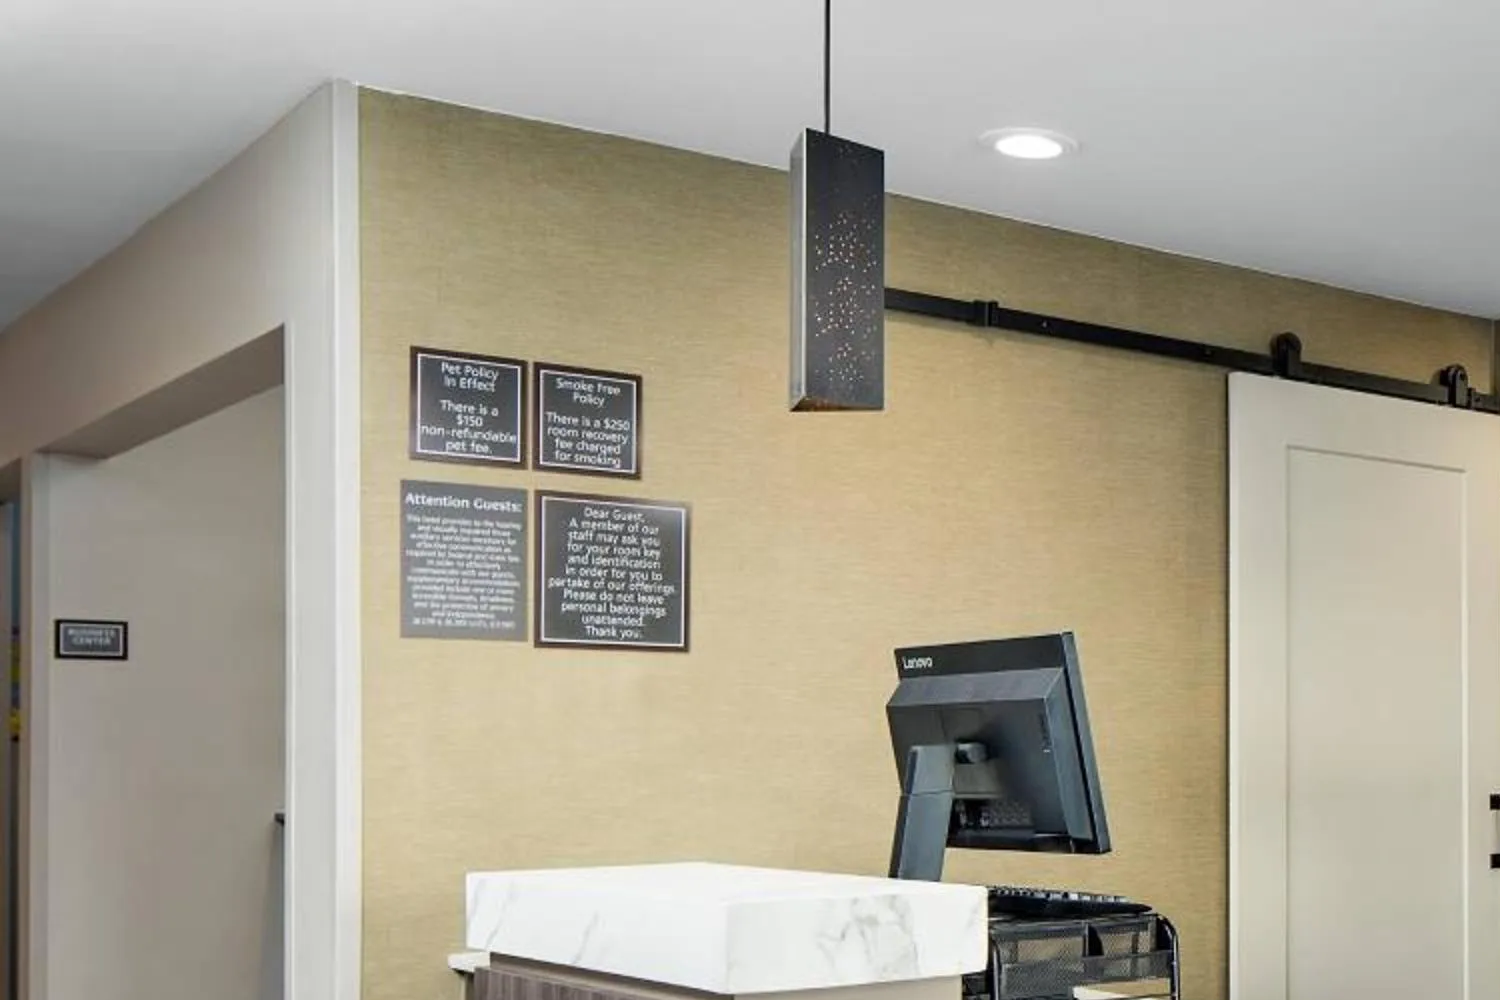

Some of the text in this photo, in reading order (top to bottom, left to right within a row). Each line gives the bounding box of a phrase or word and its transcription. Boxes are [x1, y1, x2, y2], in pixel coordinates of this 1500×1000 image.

[464, 365, 499, 381] Policy
[459, 377, 496, 392] Effect
[556, 377, 595, 393] Smoke
[573, 392, 605, 408] Policy
[440, 399, 475, 414] There
[491, 407, 499, 417] a
[456, 414, 483, 427] $150
[544, 411, 579, 425] There
[421, 425, 516, 443] non-refundable
[547, 427, 628, 445] room recovery
[445, 441, 467, 453] pet
[576, 440, 621, 455] charged
[555, 450, 572, 461] for
[405, 492, 470, 509] Attention
[583, 507, 610, 519] Dear
[569, 517, 659, 535] A member of our
[567, 530, 594, 542] staff
[596, 533, 619, 545] may
[566, 541, 584, 552] for
[586, 545, 610, 557] your
[613, 545, 640, 557] room
[567, 554, 660, 570] and identification
[579, 566, 609, 578] order
[611, 568, 626, 579] for
[628, 571, 649, 583] you
[547, 577, 590, 589] partake
[593, 578, 604, 588] of
[607, 581, 626, 591] our
[563, 588, 597, 601] Please
[599, 591, 613, 601] do
[616, 593, 635, 603] not
[561, 601, 667, 619] personal belongings
[585, 625, 617, 637] Thank
[902, 656, 933, 669] Lenovo
